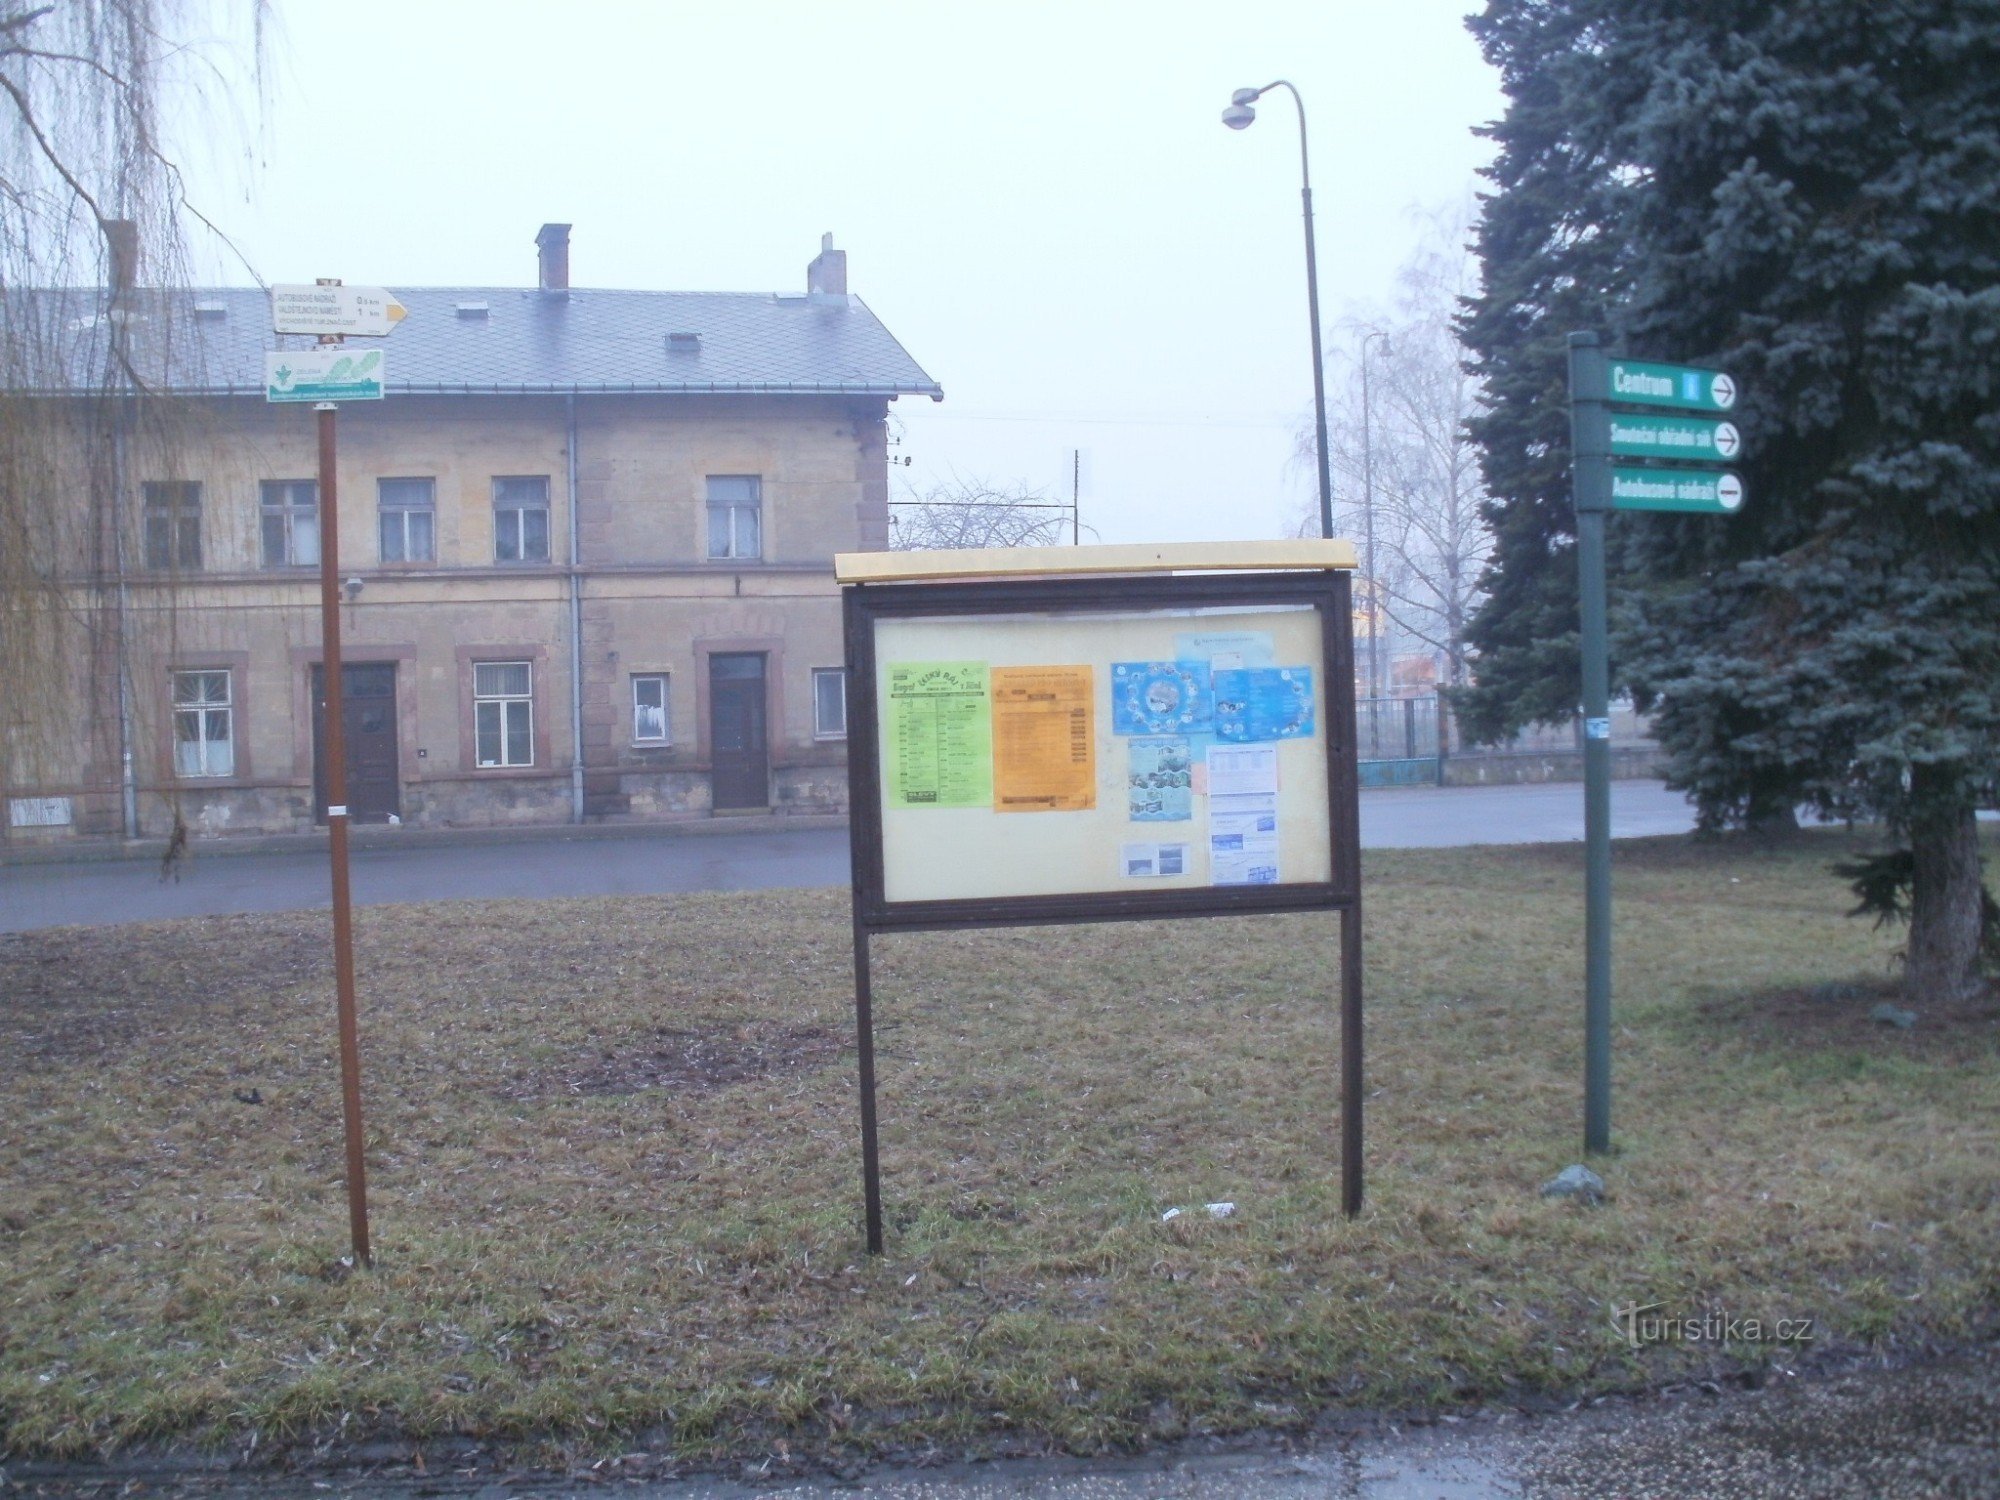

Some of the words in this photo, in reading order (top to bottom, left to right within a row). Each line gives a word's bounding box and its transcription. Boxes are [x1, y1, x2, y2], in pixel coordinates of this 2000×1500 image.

[358, 308, 362, 316] 1
[1614, 366, 1673, 396] Centrum
[1612, 476, 1676, 499] Autobusové
[1678, 479, 1715, 500] nádraží
